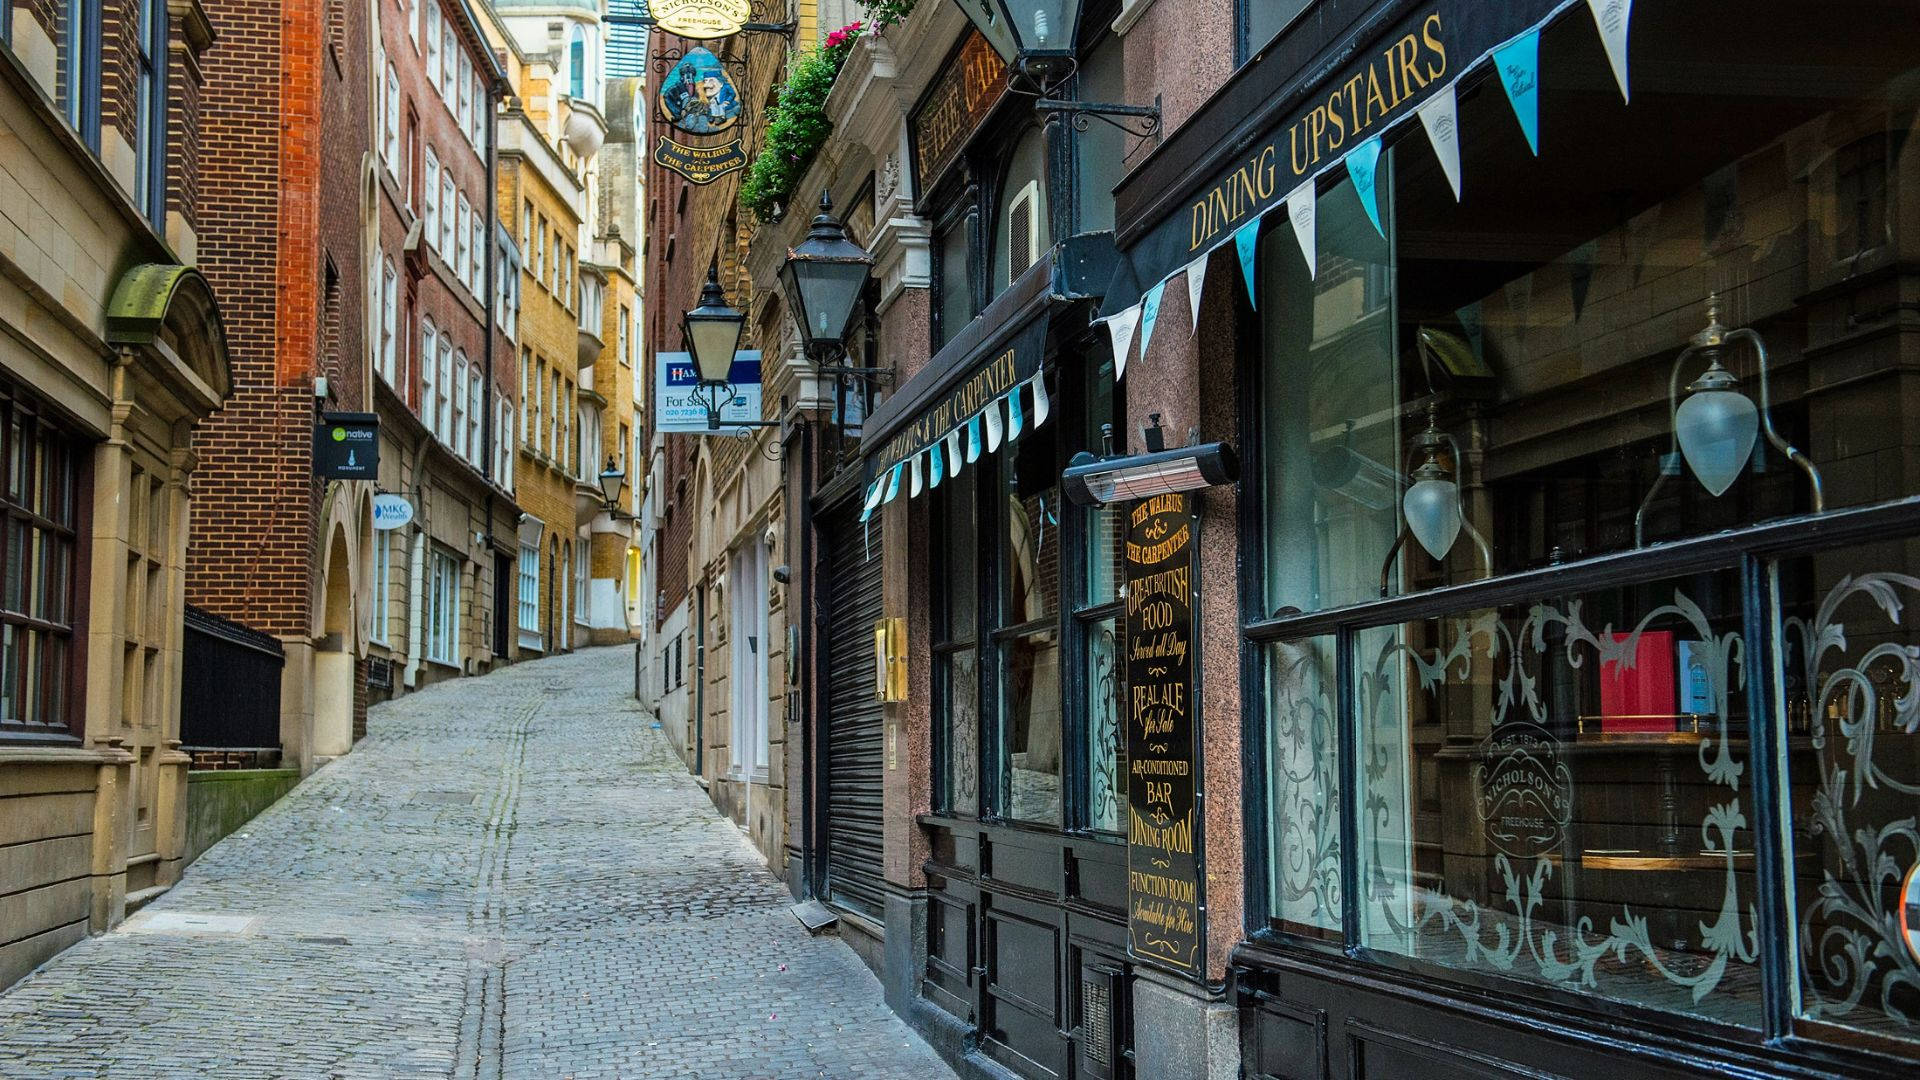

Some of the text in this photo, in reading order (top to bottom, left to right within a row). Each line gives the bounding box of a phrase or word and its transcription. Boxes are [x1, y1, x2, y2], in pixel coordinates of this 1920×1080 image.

[678, 17, 721, 25] FREEHOUSE
[1190, 11, 1447, 252] DINING UPSTAIRS
[664, 153, 683, 168] THE
[684, 156, 742, 172] CARPENTER
[672, 144, 732, 159] THE WALRUS
[666, 396, 684, 407] For
[932, 402, 951, 438] THE
[953, 348, 1016, 422] CARPENTER
[346, 429, 373, 439] native
[382, 504, 407, 512] MKC
[1132, 494, 1183, 528] THE WALRUS
[1126, 523, 1189, 564] THE CARPENTER
[1128, 565, 1189, 617] GREAT BRITISH
[1142, 600, 1173, 631] FOOD
[1130, 631, 1187, 666] Served all Day
[1133, 682, 1184, 727] REAL ALE
[1143, 707, 1174, 740] for Sale
[1131, 759, 1189, 780] AIR-CONDITIONED
[1146, 781, 1174, 816] BAR
[1485, 769, 1560, 809] NICHOLSON'S
[1130, 802, 1194, 859] DINING ROOM
[1150, 807, 1169, 825] &
[1501, 816, 1544, 829] FREEHOUSE
[1131, 871, 1193, 905] FUNCTION ROOM
[1131, 897, 1194, 935] Available for Hire
